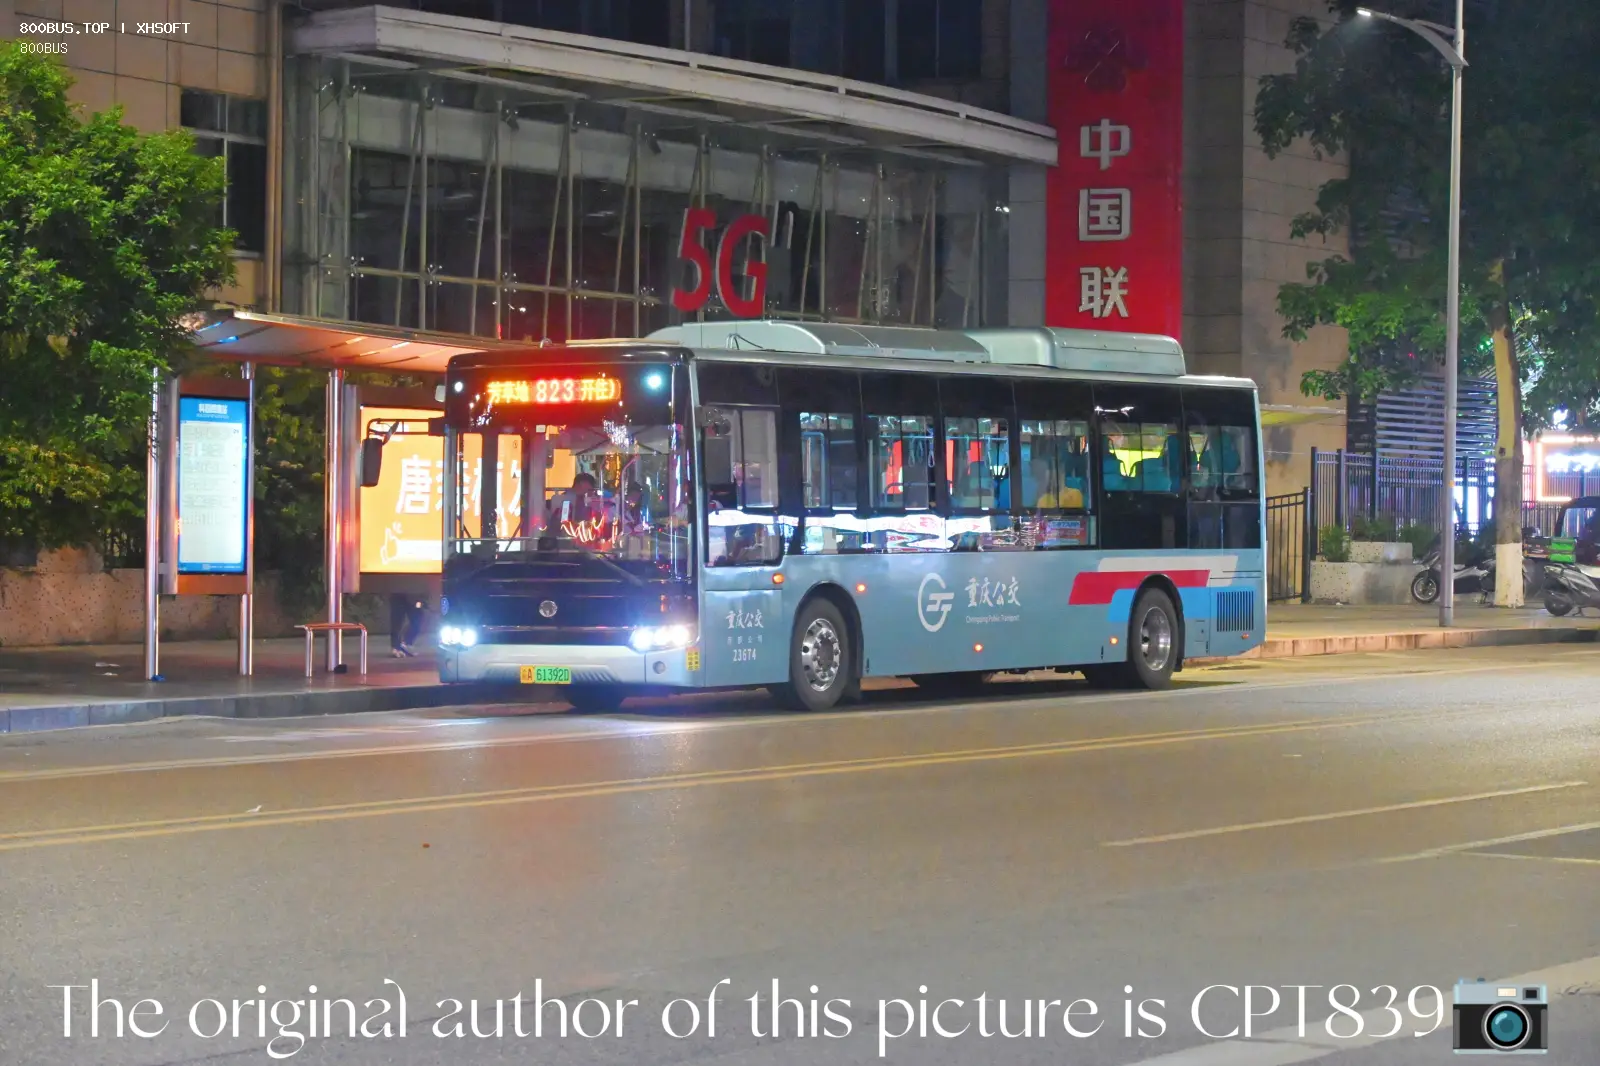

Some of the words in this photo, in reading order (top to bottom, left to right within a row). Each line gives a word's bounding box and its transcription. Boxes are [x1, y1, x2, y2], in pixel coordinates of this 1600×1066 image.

[1078, 118, 1132, 318] 中国联
[536, 379, 574, 402] 823
[964, 576, 1021, 607] 重庆公交
[725, 609, 764, 629] 重庆公交
[733, 648, 756, 662] 23674
